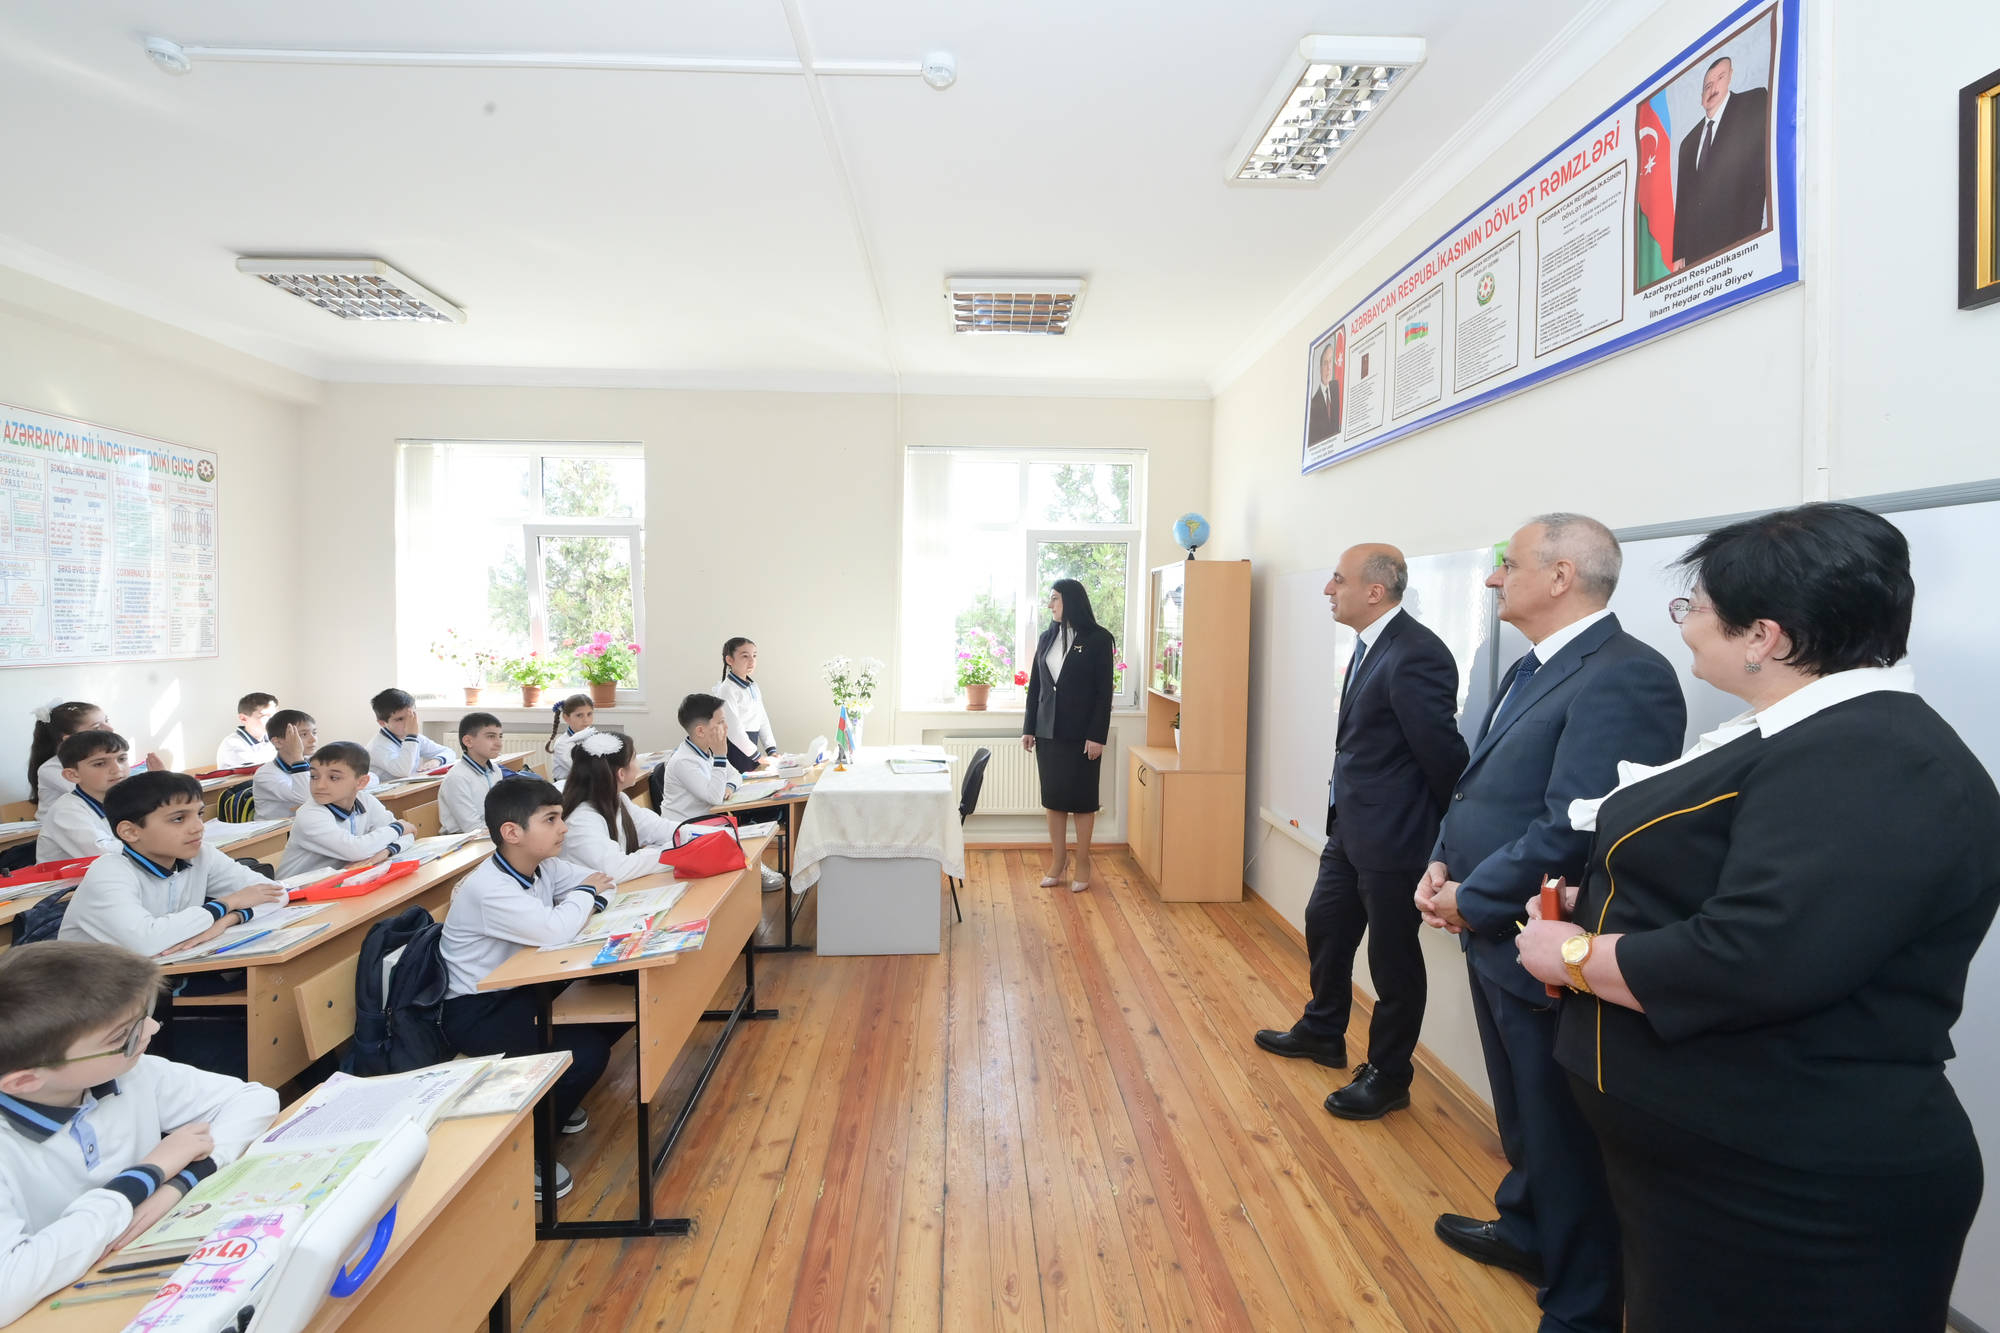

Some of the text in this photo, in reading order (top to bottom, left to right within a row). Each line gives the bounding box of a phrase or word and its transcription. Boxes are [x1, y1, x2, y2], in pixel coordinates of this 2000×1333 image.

[1350, 292, 1397, 334] AZƏRBAYCAN
[1397, 232, 1483, 301] RESPUBLİKASININ
[1485, 186, 1535, 240] DÖVLƏT
[1540, 119, 1621, 201] RƏMZLƏRİ
[1643, 242, 1760, 301] Azərbaycan Respublikasının
[1649, 269, 1754, 319] İlham Heydər oğlu Əliyev
[1664, 266, 1733, 302] Prezidenti cənab
[3, 419, 79, 454] AZƏRBAYCAN
[81, 431, 126, 465] DİLİNDƏN
[171, 455, 194, 482] GUŞƏ
[187, 1240, 249, 1262] AYLA
